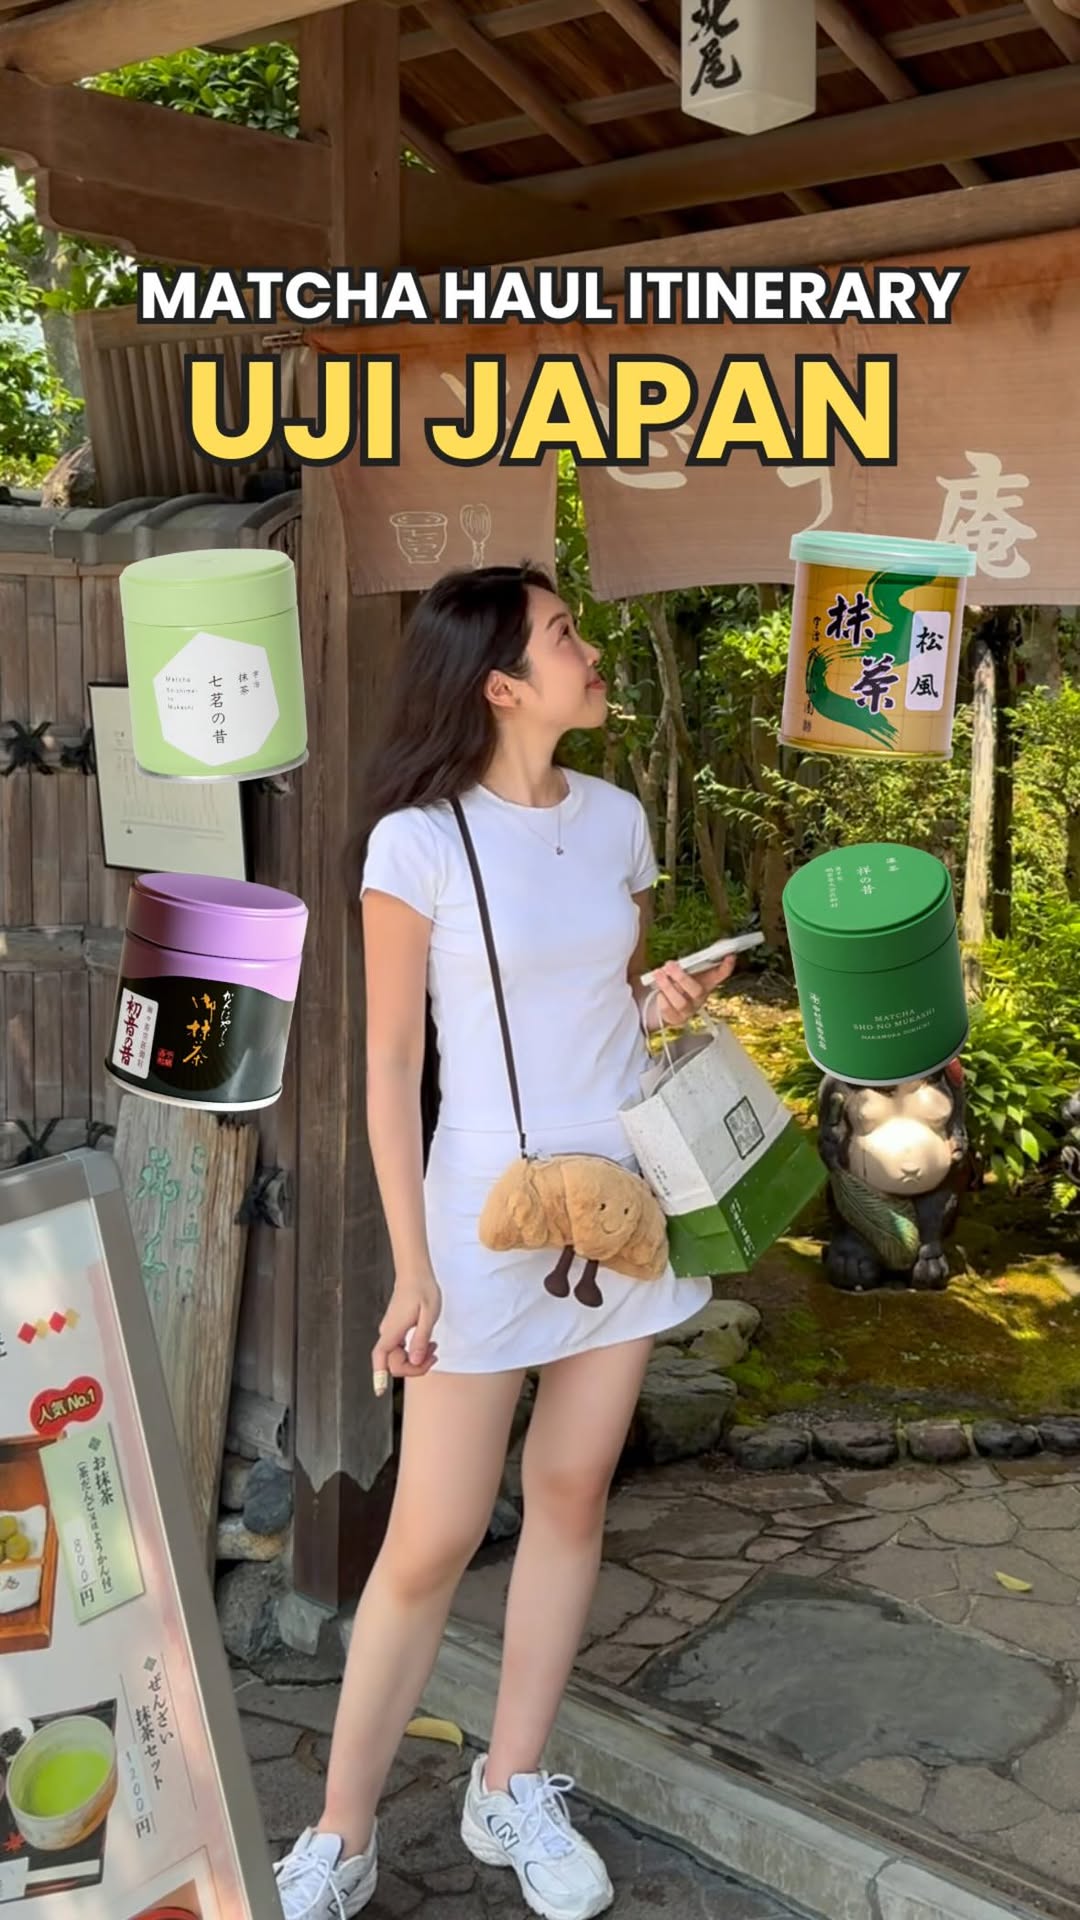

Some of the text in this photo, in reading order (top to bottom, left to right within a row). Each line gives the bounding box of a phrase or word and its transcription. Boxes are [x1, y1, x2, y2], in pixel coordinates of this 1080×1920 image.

[826, 592, 899, 715] 抹茶
[911, 626, 944, 698] 松風
[208, 675, 227, 744] 七茗の昔
[119, 994, 142, 1066] 初昔の昔
[853, 1008, 936, 1031] SHO NO MUKASHI
[874, 1009, 916, 1022] MATCHA
[93, 1456, 114, 1506] お抹茶
[148, 1672, 174, 1744] ぜんざい
[135, 1705, 163, 1790] 抹茶セット
